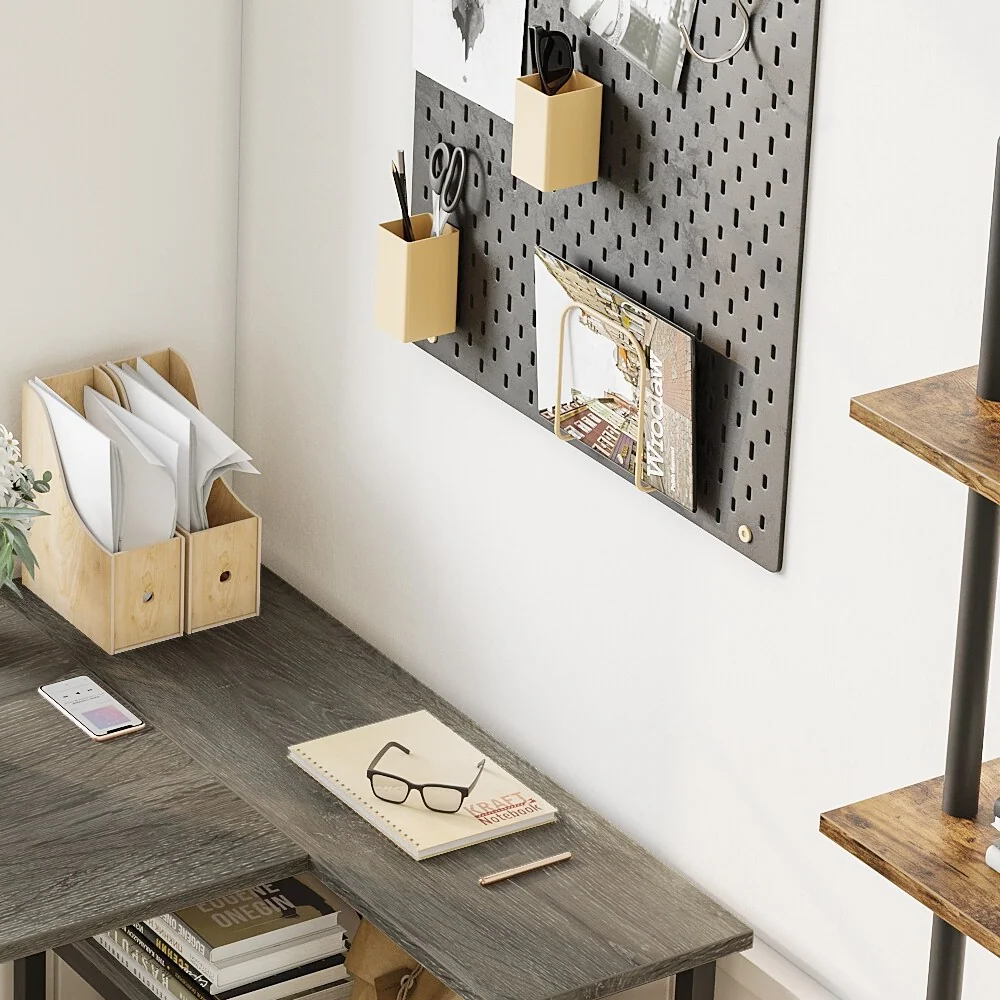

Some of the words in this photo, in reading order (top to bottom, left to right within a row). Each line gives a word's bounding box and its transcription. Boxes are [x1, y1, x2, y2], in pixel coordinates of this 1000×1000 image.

[463, 791, 527, 817] KRAFT
[478, 803, 542, 826] Notebook
[211, 894, 297, 928] ONEGIN
[178, 923, 206, 956] EUGENE
